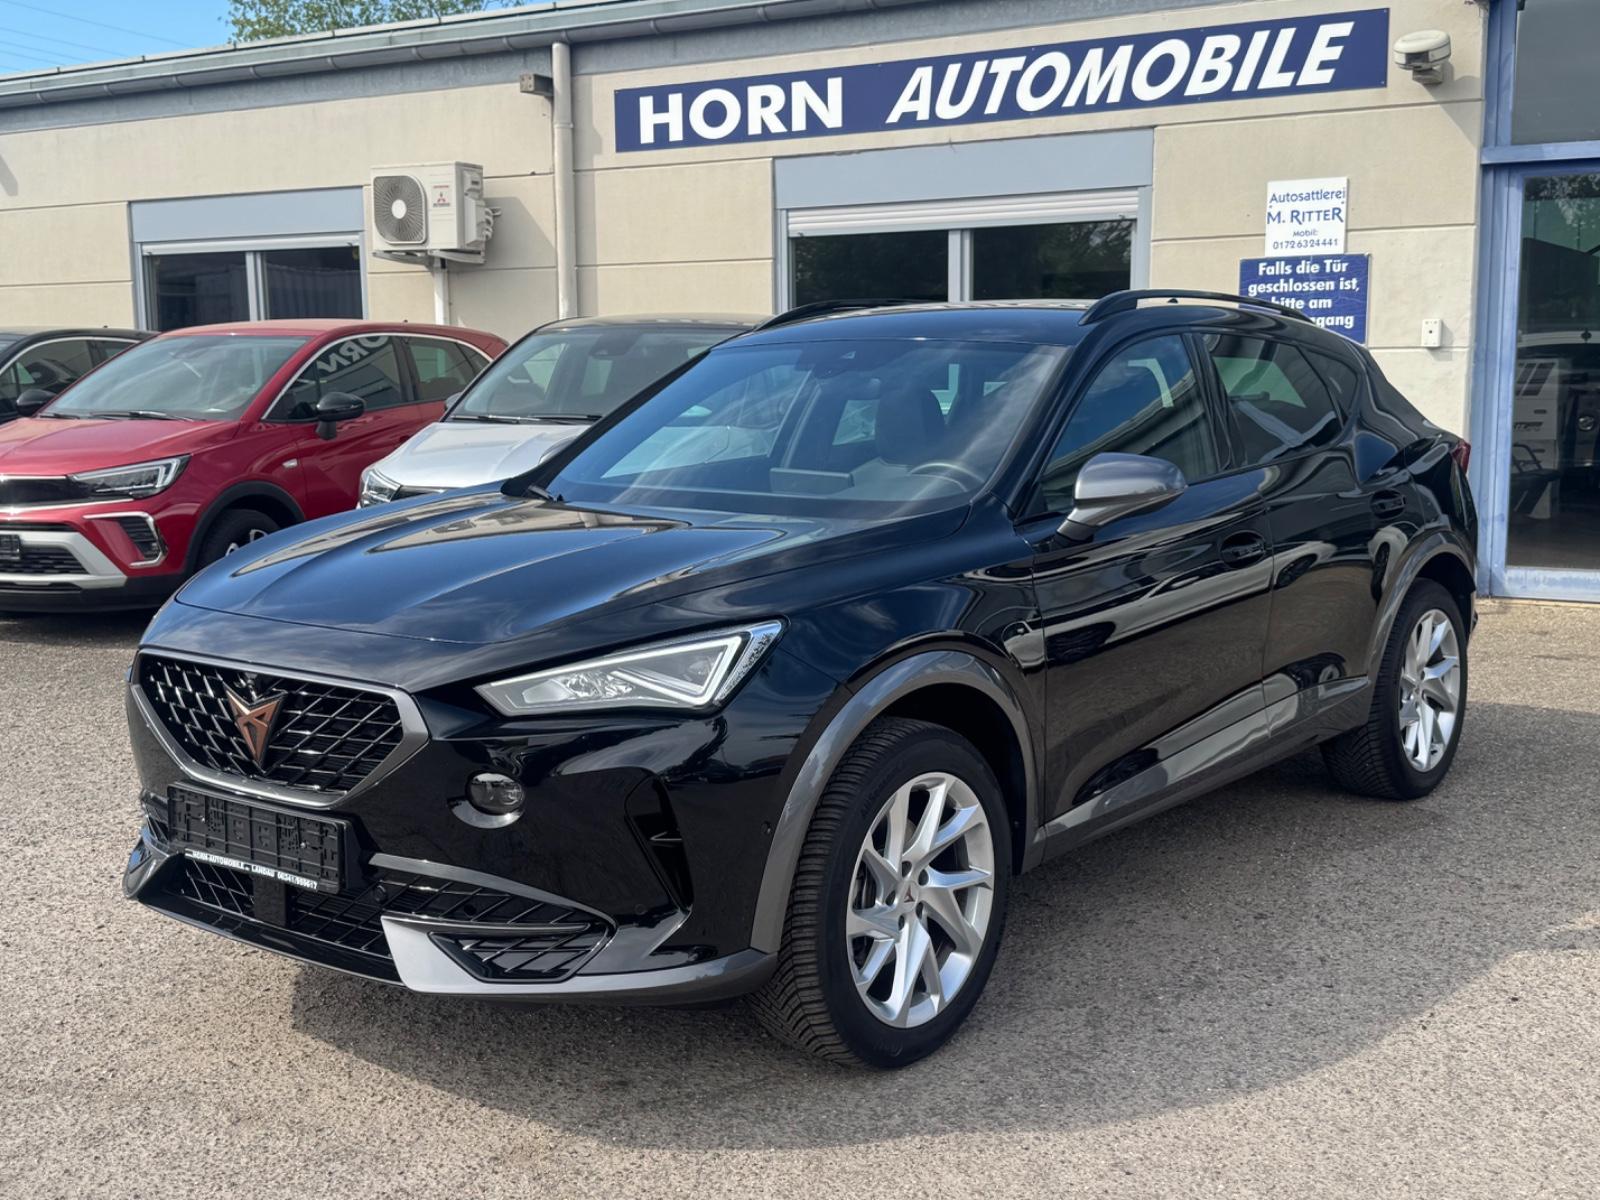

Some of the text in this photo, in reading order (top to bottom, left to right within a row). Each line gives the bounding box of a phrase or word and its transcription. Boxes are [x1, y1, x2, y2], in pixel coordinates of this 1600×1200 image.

[638, 22, 1354, 144] HORN AUTOMOBILE
[1269, 187, 1346, 203] Autosattlerei
[1266, 211, 1286, 225] M.
[1258, 259, 1349, 276] Falls die Tür
[1248, 277, 1360, 296] geschlossen ist,
[1308, 298, 1332, 309] am
